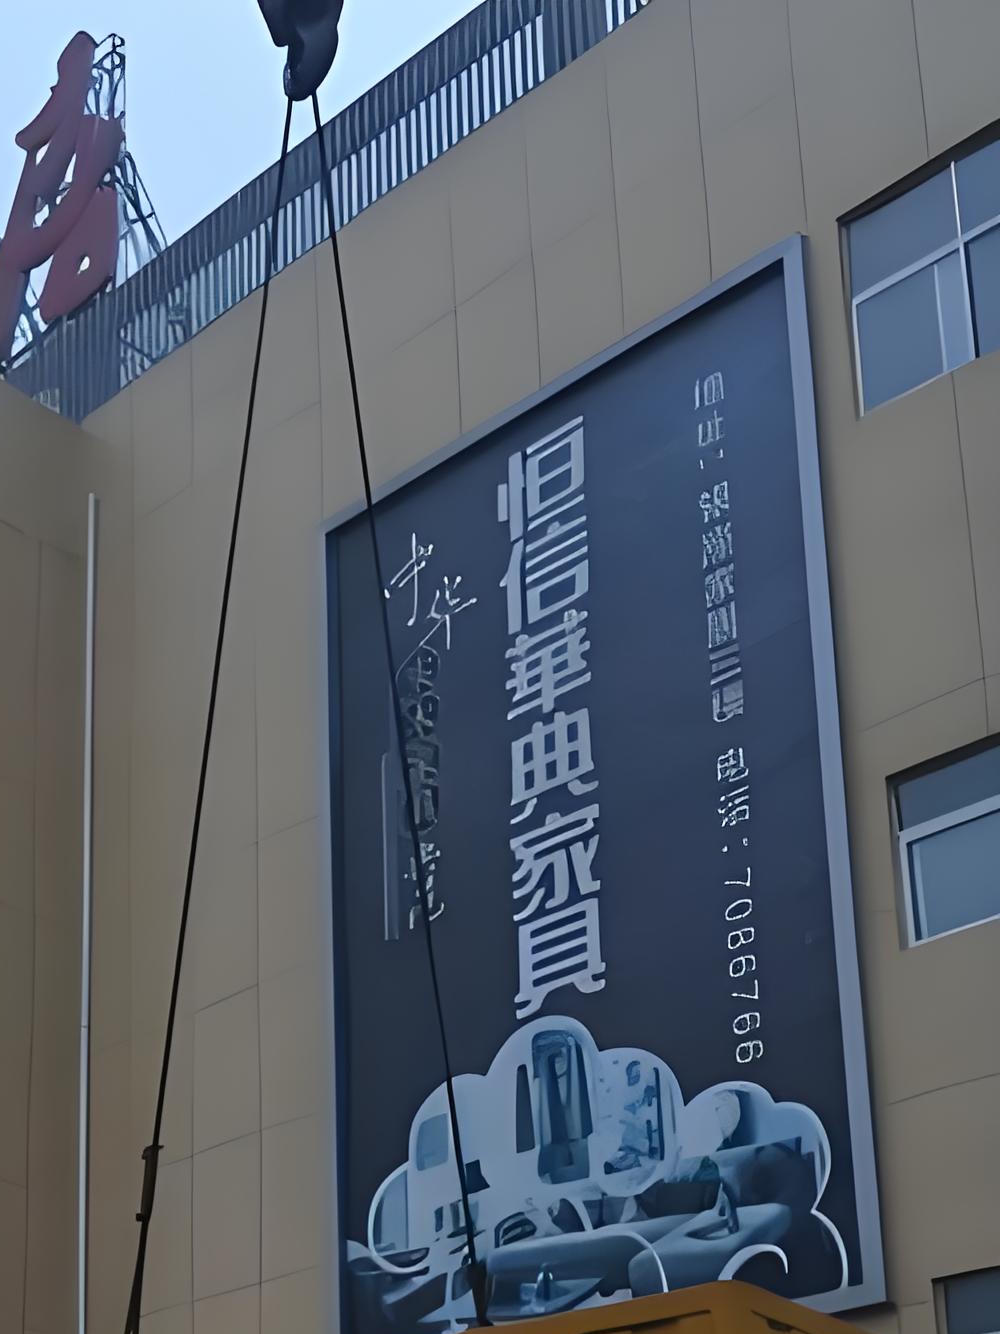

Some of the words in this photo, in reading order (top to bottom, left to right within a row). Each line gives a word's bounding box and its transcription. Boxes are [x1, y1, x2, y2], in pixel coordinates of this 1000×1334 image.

[498, 415, 606, 1020] 恒信華典家具
